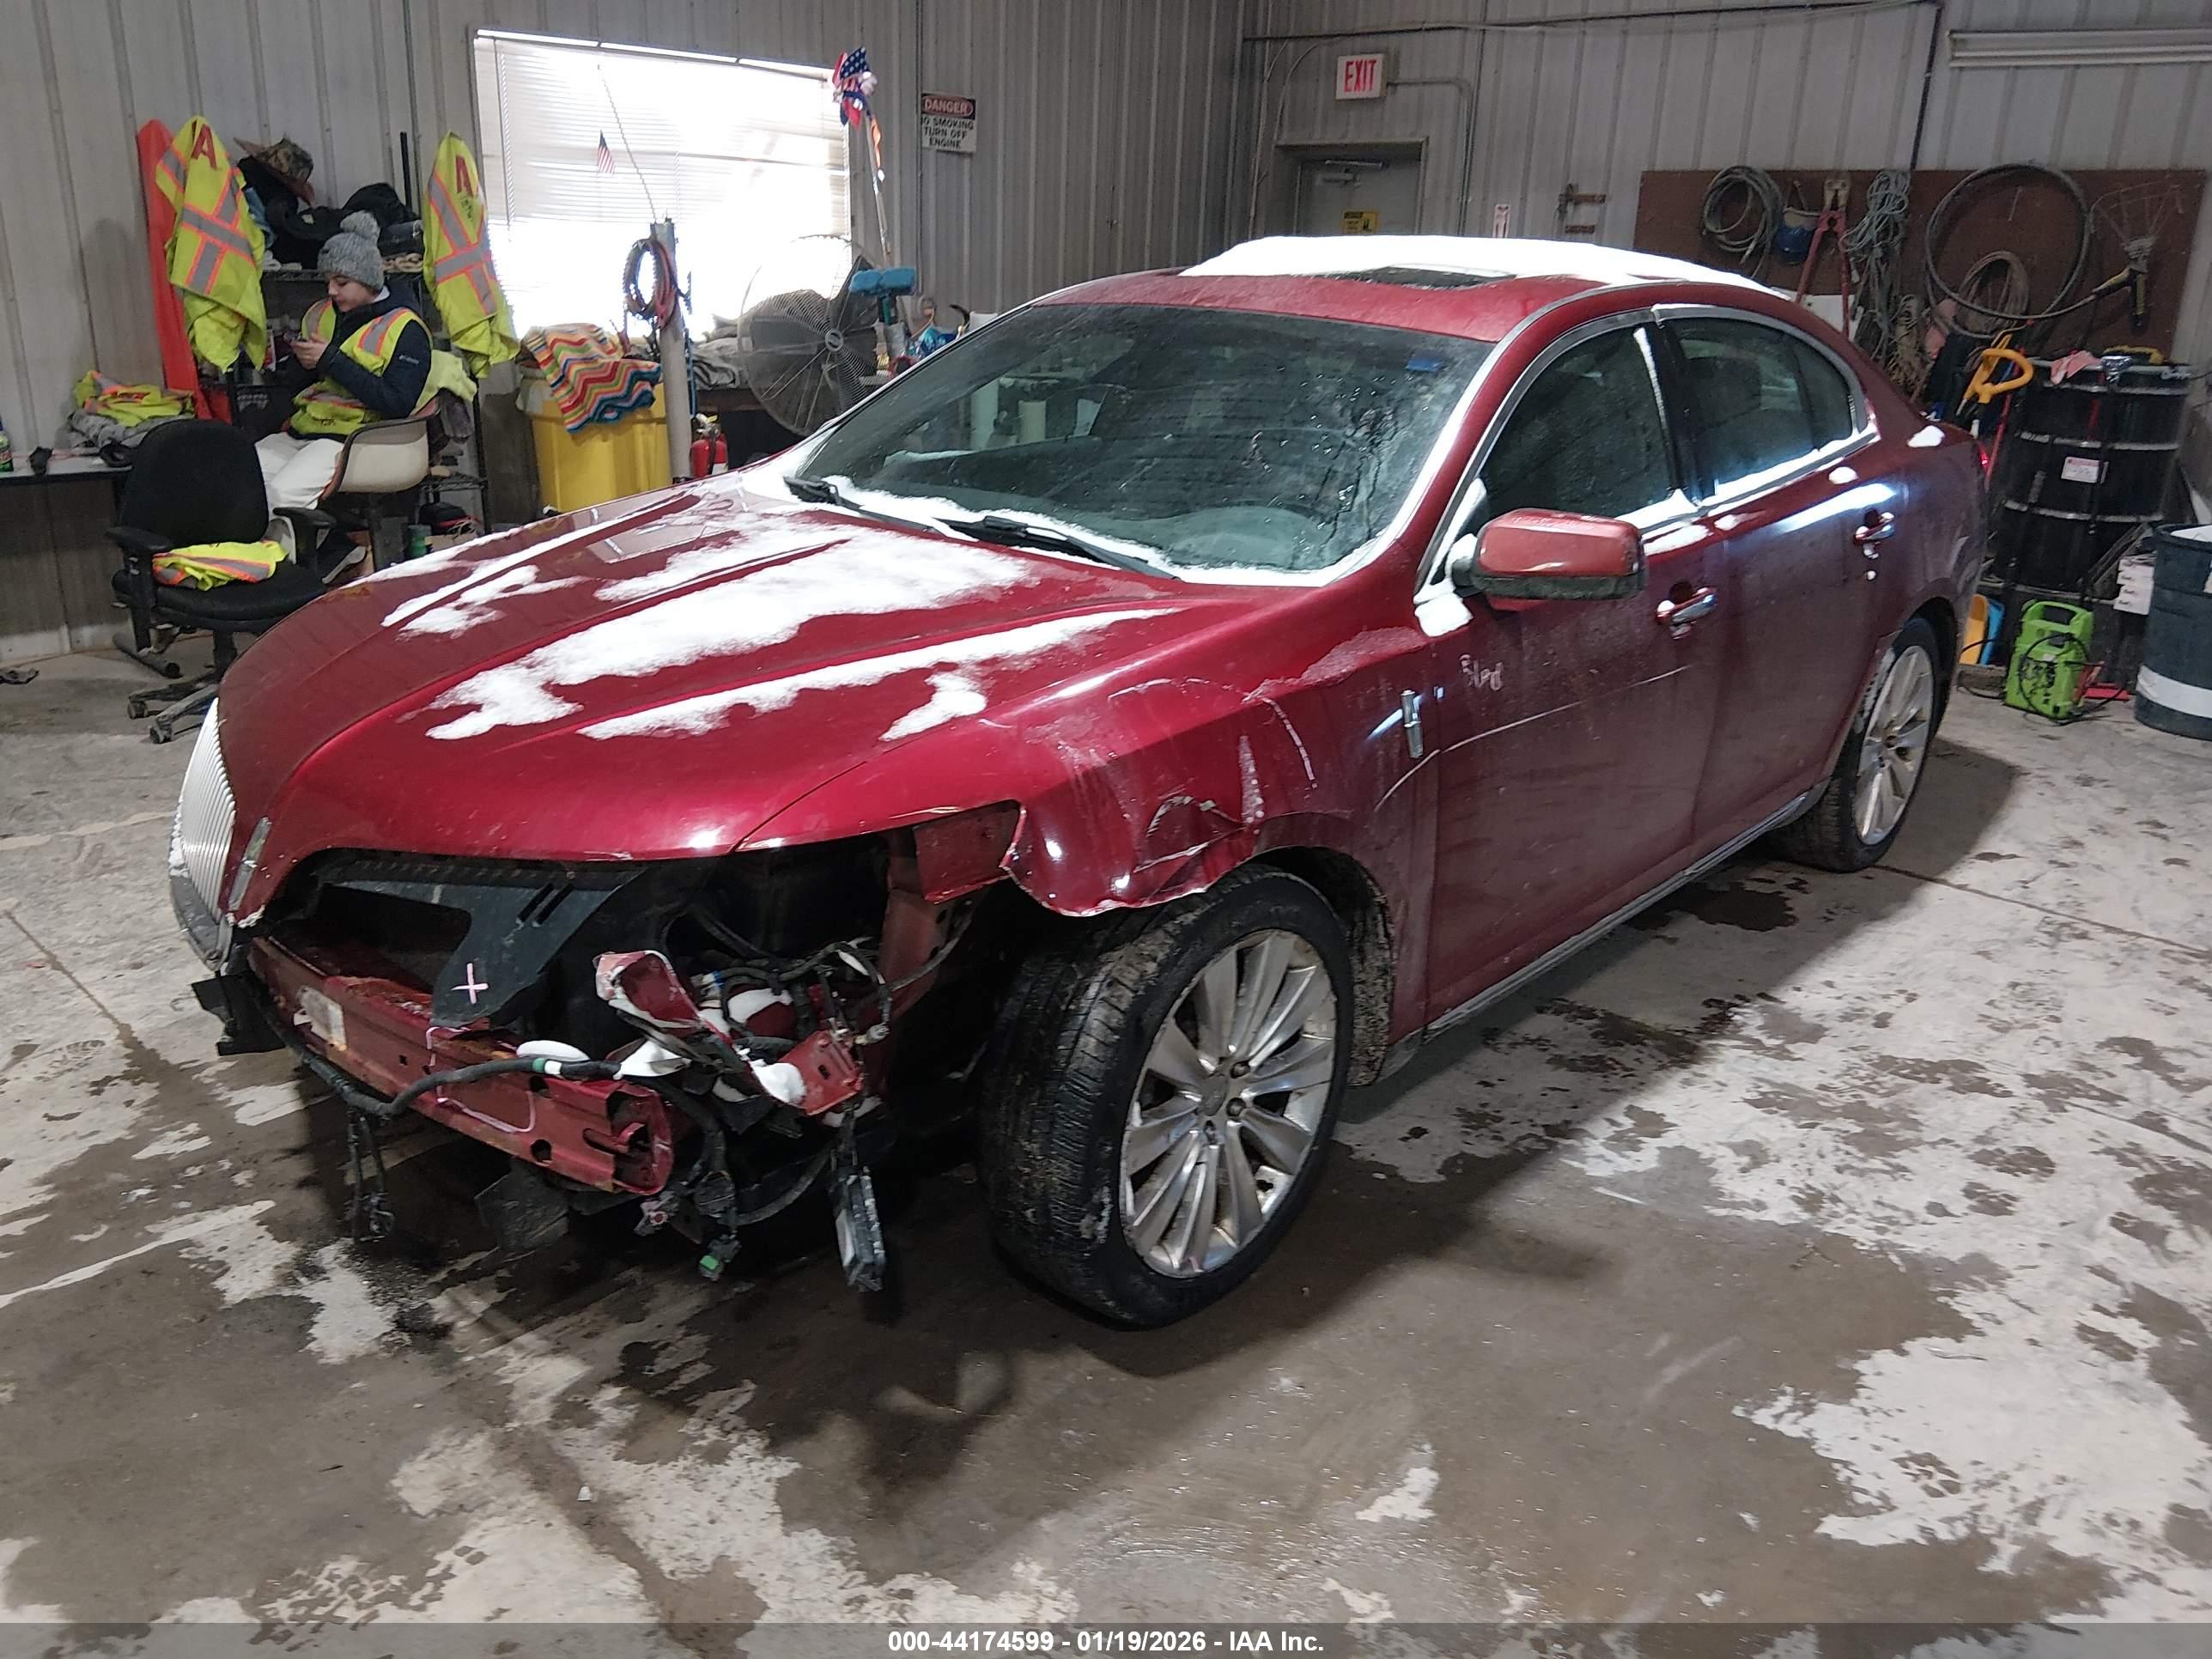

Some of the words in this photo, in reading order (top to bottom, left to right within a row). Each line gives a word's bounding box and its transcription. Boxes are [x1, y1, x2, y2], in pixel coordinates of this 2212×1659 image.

[1344, 59, 1376, 93] EXIT
[925, 99, 969, 114] DANGER
[933, 118, 974, 130] SMOKING
[924, 126, 947, 137] TURN
[950, 129, 967, 140] OFF
[929, 137, 962, 149] ENGINE
